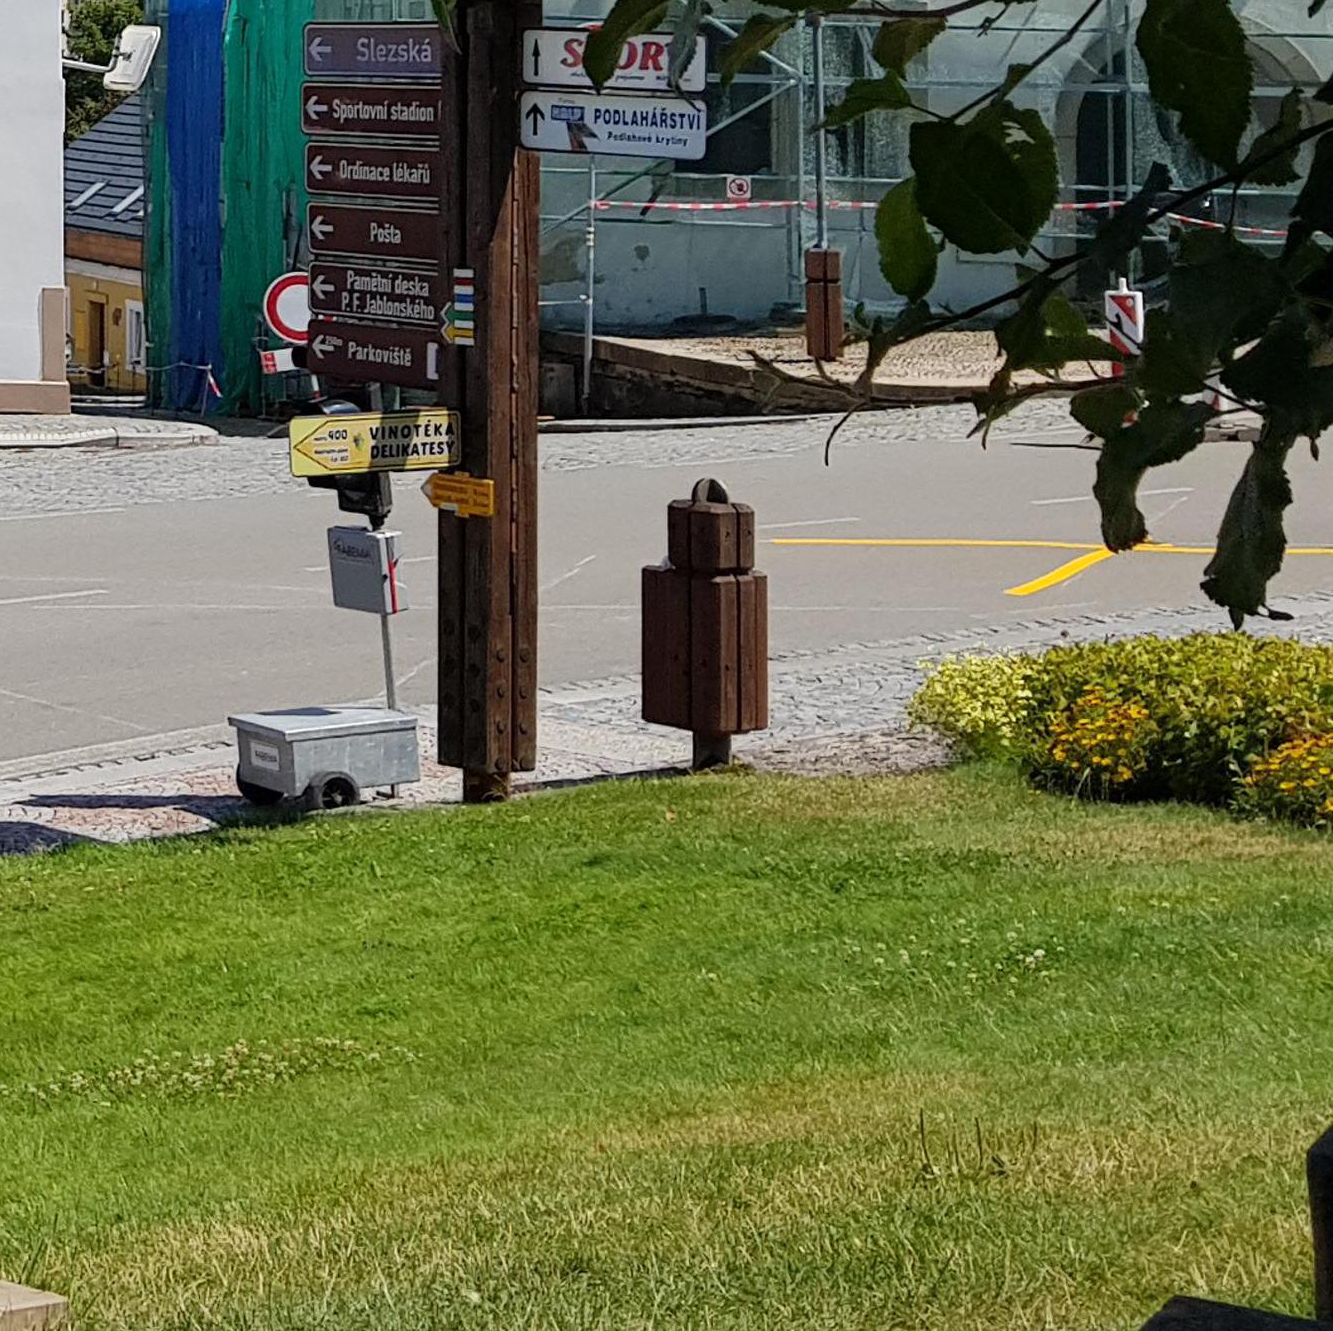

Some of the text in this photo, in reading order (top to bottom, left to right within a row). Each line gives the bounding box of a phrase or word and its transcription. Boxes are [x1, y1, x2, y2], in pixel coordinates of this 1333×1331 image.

[356, 37, 432, 62] Slezská
[332, 98, 434, 123] Sportovní stadion
[594, 107, 701, 130] PODLAHÁŘSTVÍ
[339, 159, 430, 184] Ordinace lékařů
[370, 222, 401, 244] Pošta
[347, 270, 429, 297] Pamětní deska
[341, 291, 435, 320] P. F. Jablonského
[348, 341, 412, 367] Parkoviště
[369, 420, 455, 440] VINOTÉKA
[371, 440, 455, 459] DELIKATESY
